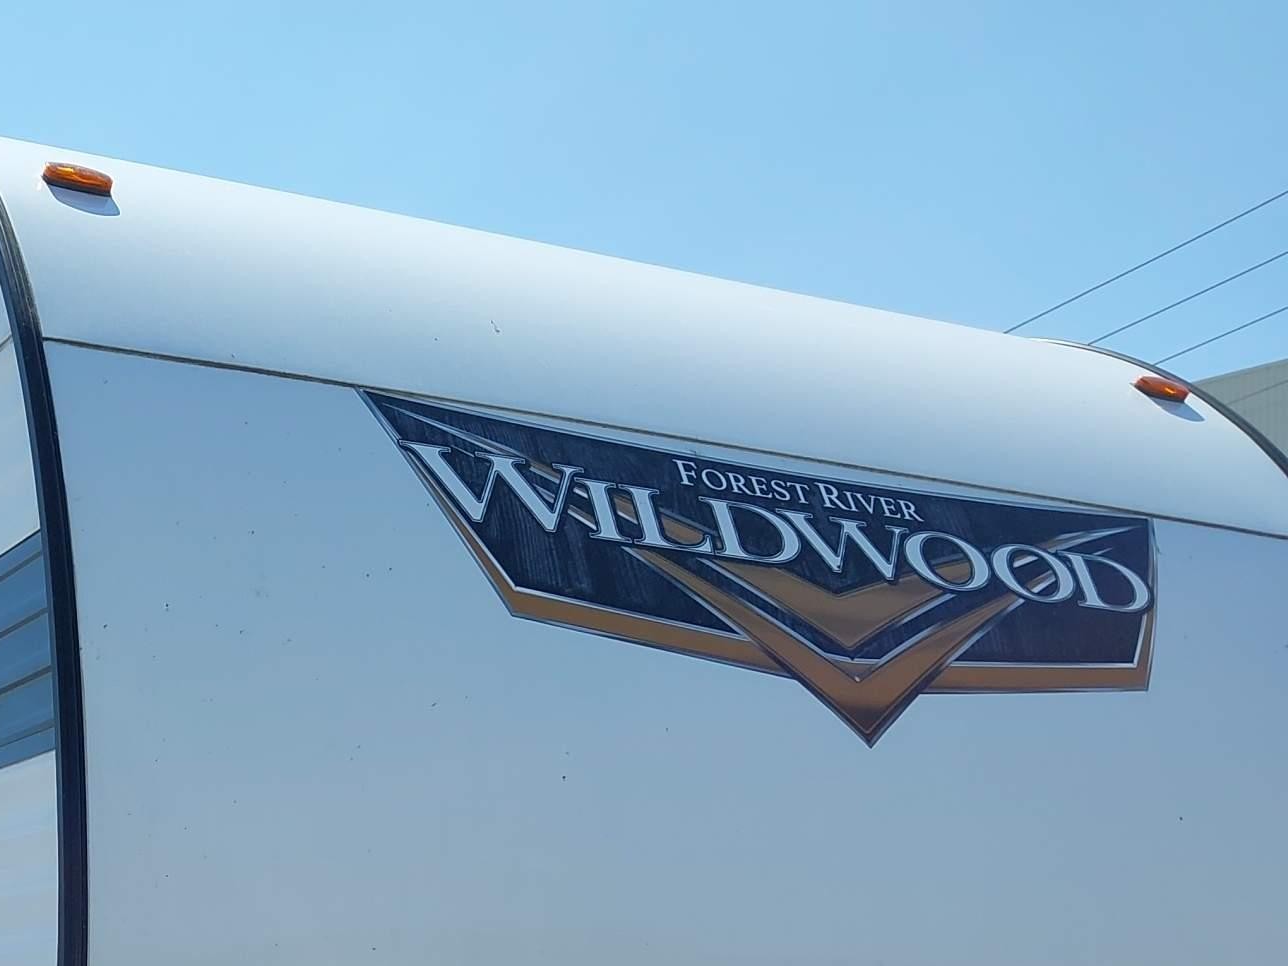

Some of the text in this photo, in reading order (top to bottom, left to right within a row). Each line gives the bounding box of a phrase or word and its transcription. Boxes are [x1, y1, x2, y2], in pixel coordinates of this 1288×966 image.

[398, 439, 1154, 613] WILDWOOD
[672, 458, 925, 523] FOREST RIVER
